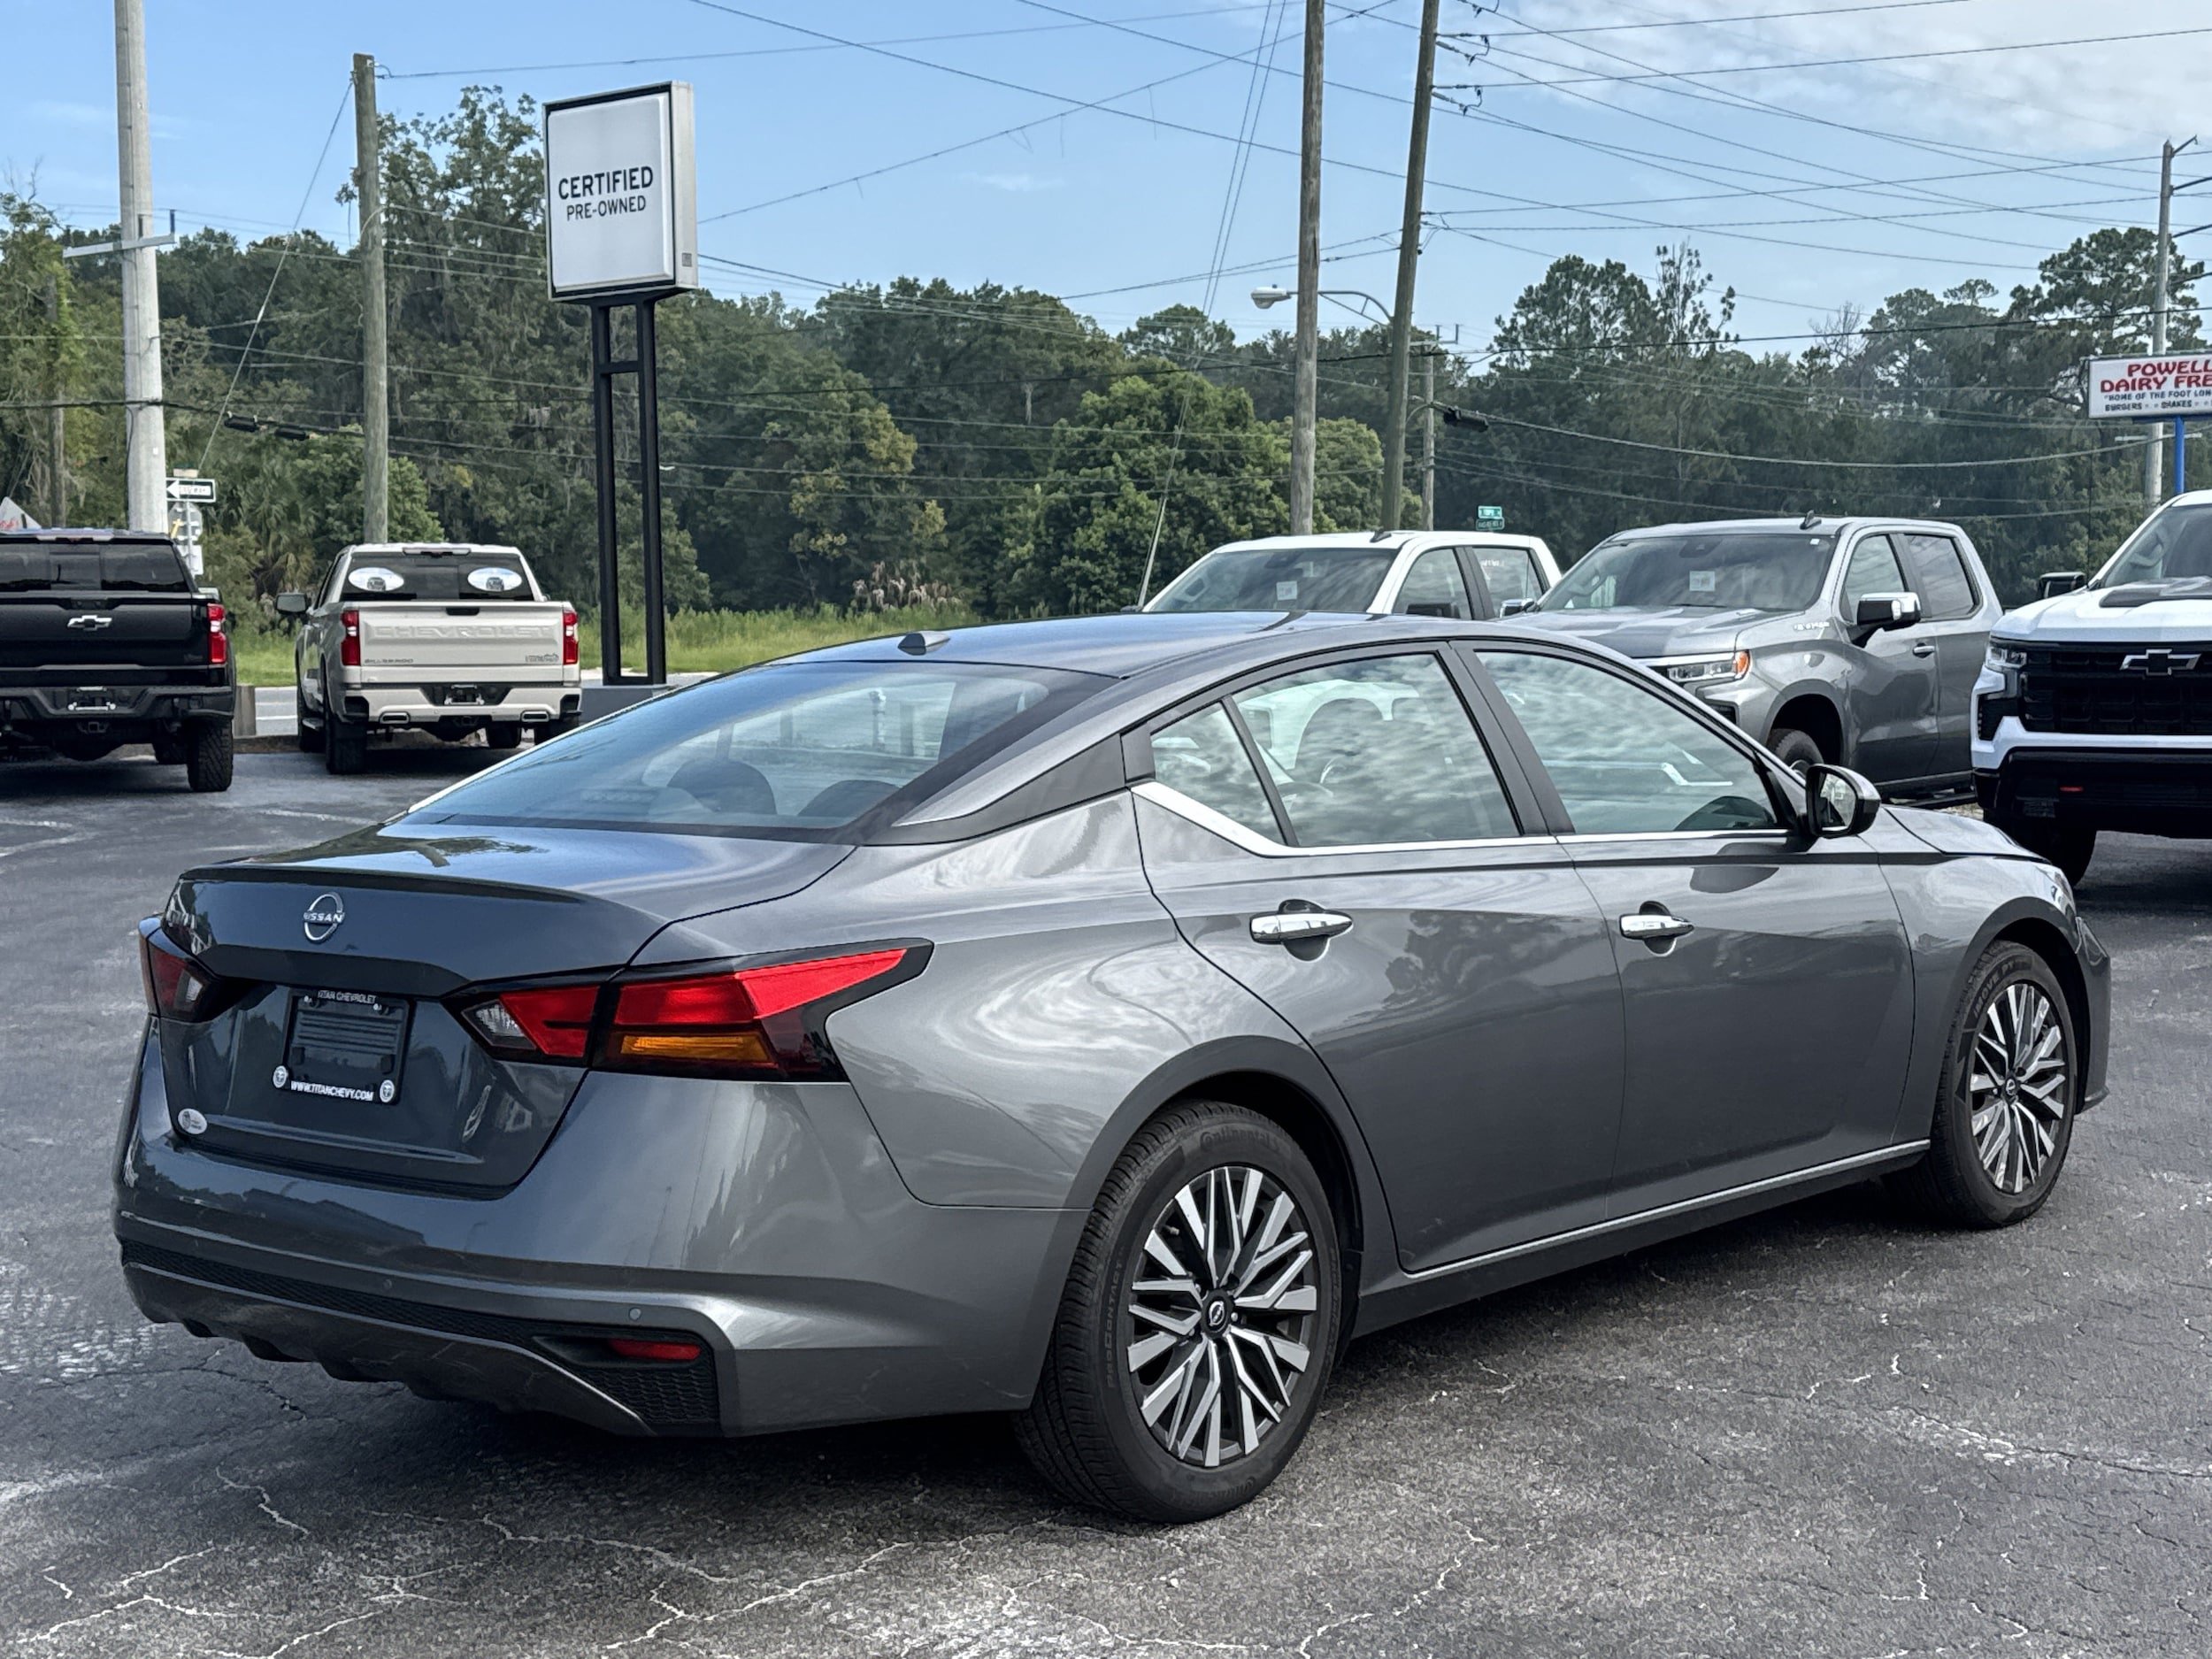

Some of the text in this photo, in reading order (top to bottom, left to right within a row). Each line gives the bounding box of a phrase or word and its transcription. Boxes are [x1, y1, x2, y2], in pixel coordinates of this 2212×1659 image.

[558, 165, 654, 200] CERTIFIED
[566, 195, 647, 221] PRE-OWNED
[2101, 376, 2167, 393] DAIRY
[2168, 389, 2192, 398] FOOT
[2105, 402, 2142, 411] BURGERS
[373, 625, 550, 639] CHEVROLET
[303, 911, 346, 923] NISSAN
